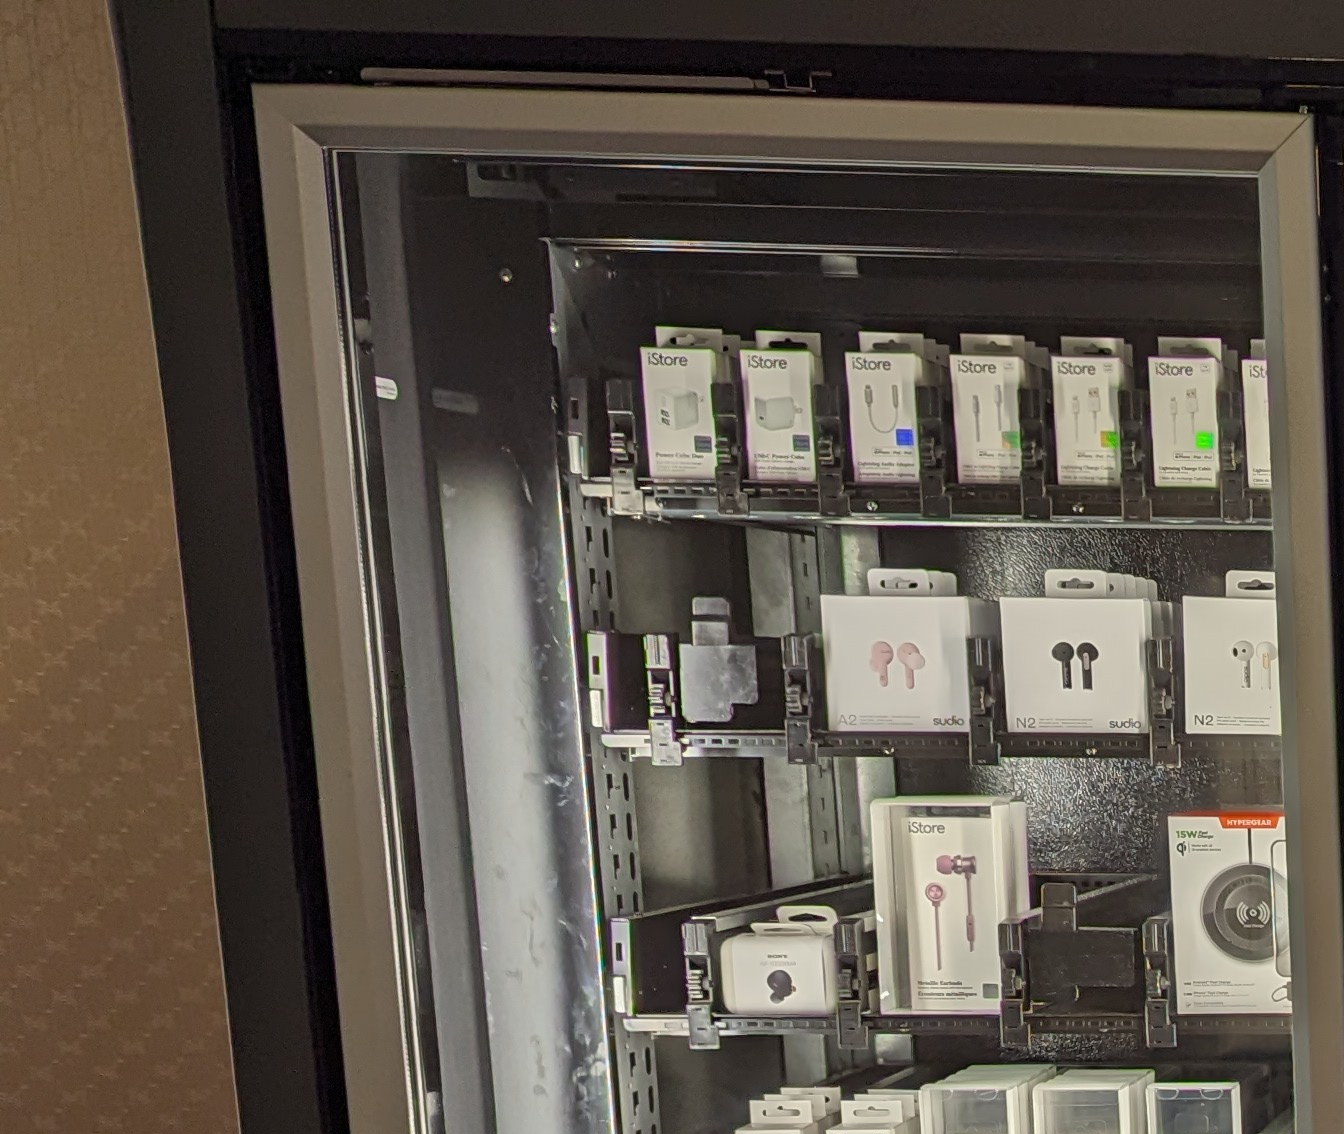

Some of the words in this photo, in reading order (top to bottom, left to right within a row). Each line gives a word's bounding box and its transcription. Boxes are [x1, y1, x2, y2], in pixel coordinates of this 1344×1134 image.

[647, 352, 688, 367] iStore
[747, 356, 788, 370] iStore
[851, 357, 892, 371] iStore
[957, 360, 997, 374] iStore
[1057, 361, 1096, 376] iStore
[1155, 362, 1193, 376] iStore
[839, 714, 857, 726] A2
[933, 714, 965, 727] sudio
[1016, 717, 1036, 729] N2
[1109, 716, 1142, 729] sudio
[1194, 715, 1214, 727] N2
[907, 821, 945, 835] iStore
